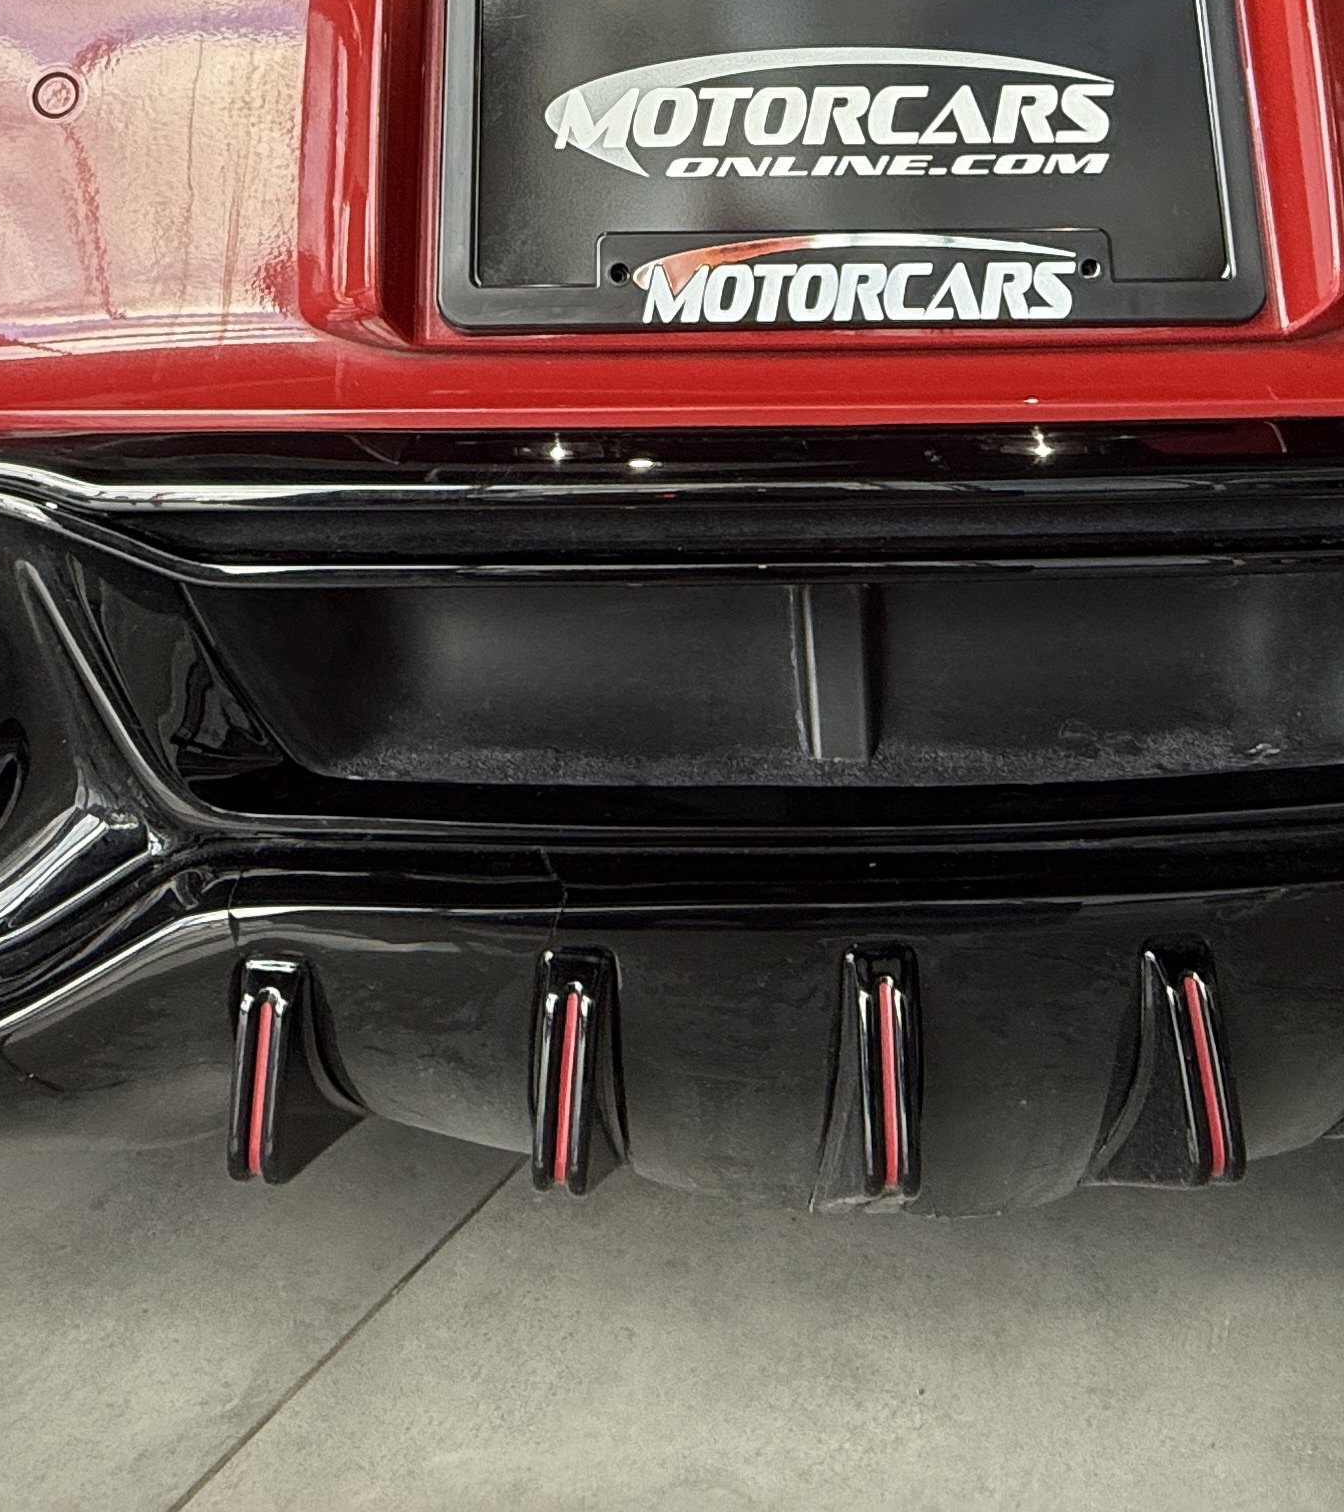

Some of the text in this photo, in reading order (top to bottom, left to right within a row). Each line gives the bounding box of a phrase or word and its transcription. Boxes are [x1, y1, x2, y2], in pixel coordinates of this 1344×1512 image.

[555, 85, 1113, 149] MOTORCARS
[665, 153, 1110, 178] ONLINE.COM
[642, 261, 1077, 325] MOTORCARS
